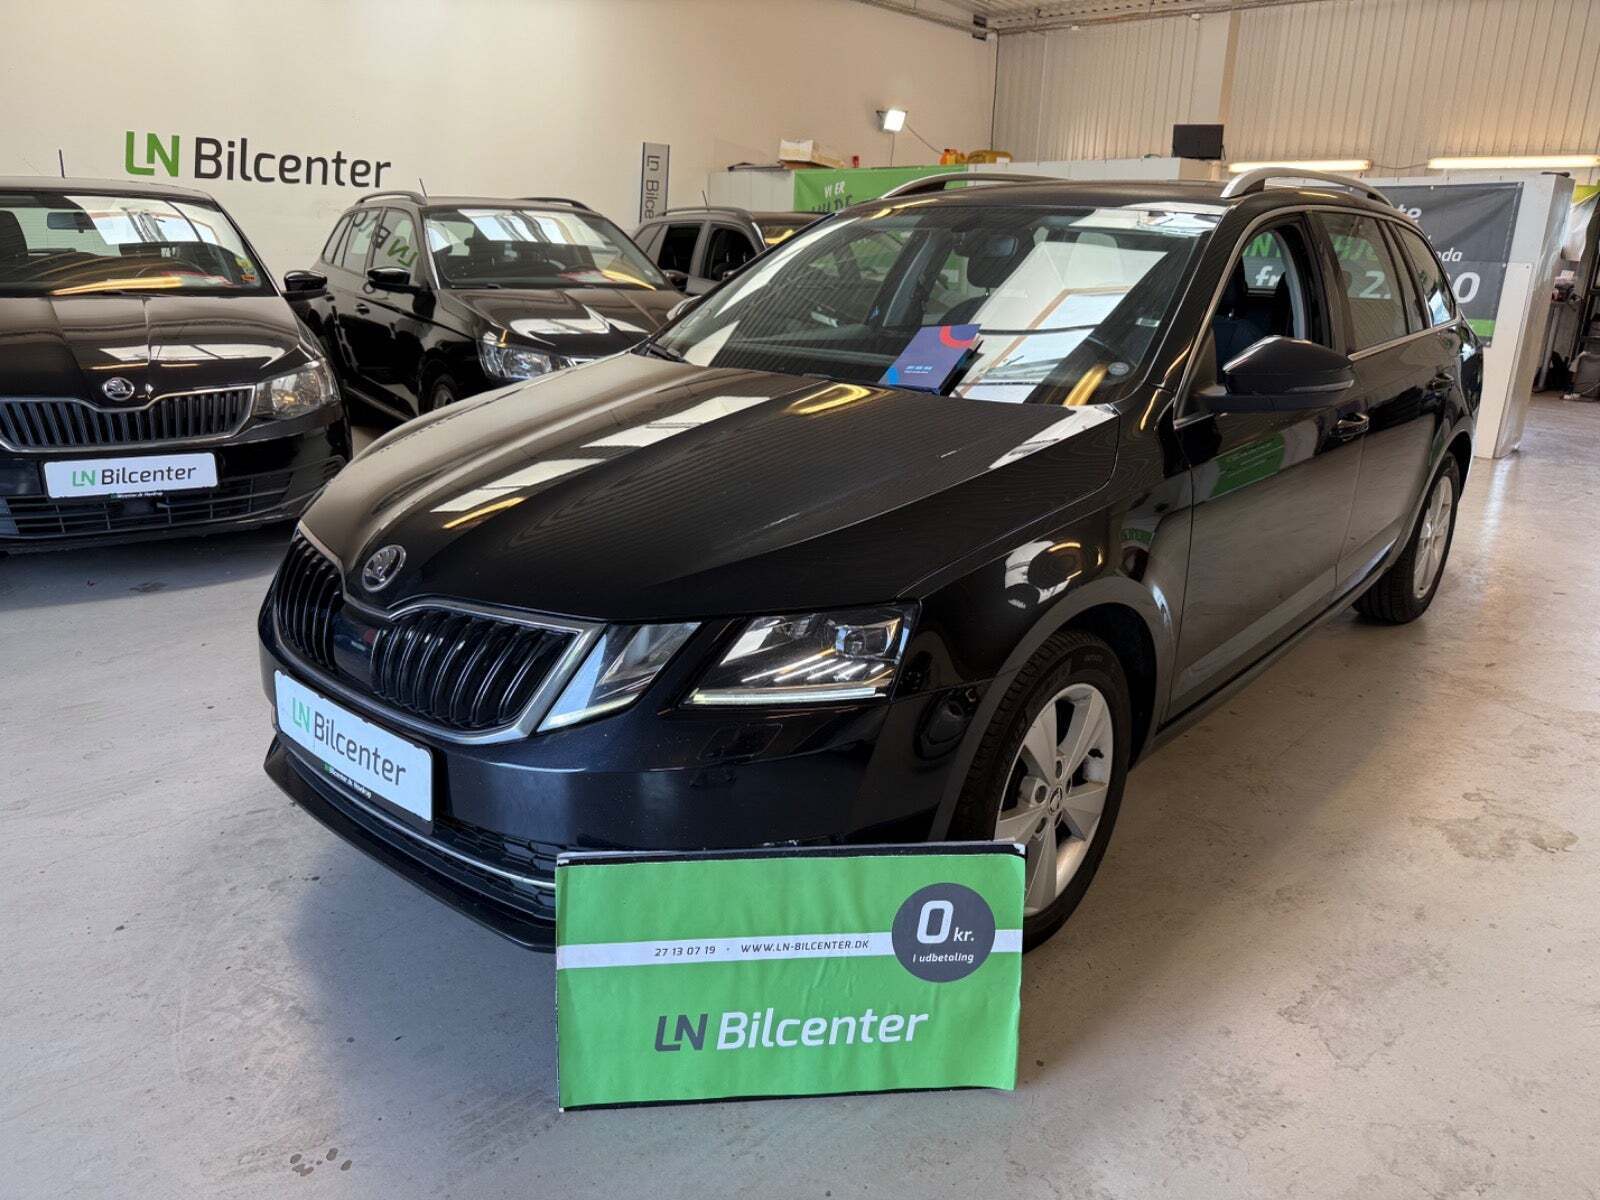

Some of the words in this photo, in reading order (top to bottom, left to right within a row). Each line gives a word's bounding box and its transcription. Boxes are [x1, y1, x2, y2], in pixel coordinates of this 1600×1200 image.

[125, 131, 180, 177] LN
[194, 137, 392, 188] Bilcenter
[71, 470, 97, 487] LN
[101, 466, 197, 485] Bilcenter
[292, 697, 311, 734] LN
[314, 710, 407, 787] Bilcenter
[916, 900, 954, 944] 0
[953, 926, 975, 942] kr.
[654, 947, 668, 957] 27
[671, 946, 684, 956] 13
[686, 945, 701, 956] 07
[704, 945, 716, 955] 19
[741, 939, 870, 953] WWW.LN-BILCENTER.DK
[919, 952, 975, 965] udbetaling
[654, 1013, 708, 1051] LN
[716, 1007, 929, 1051] Bilcenter
